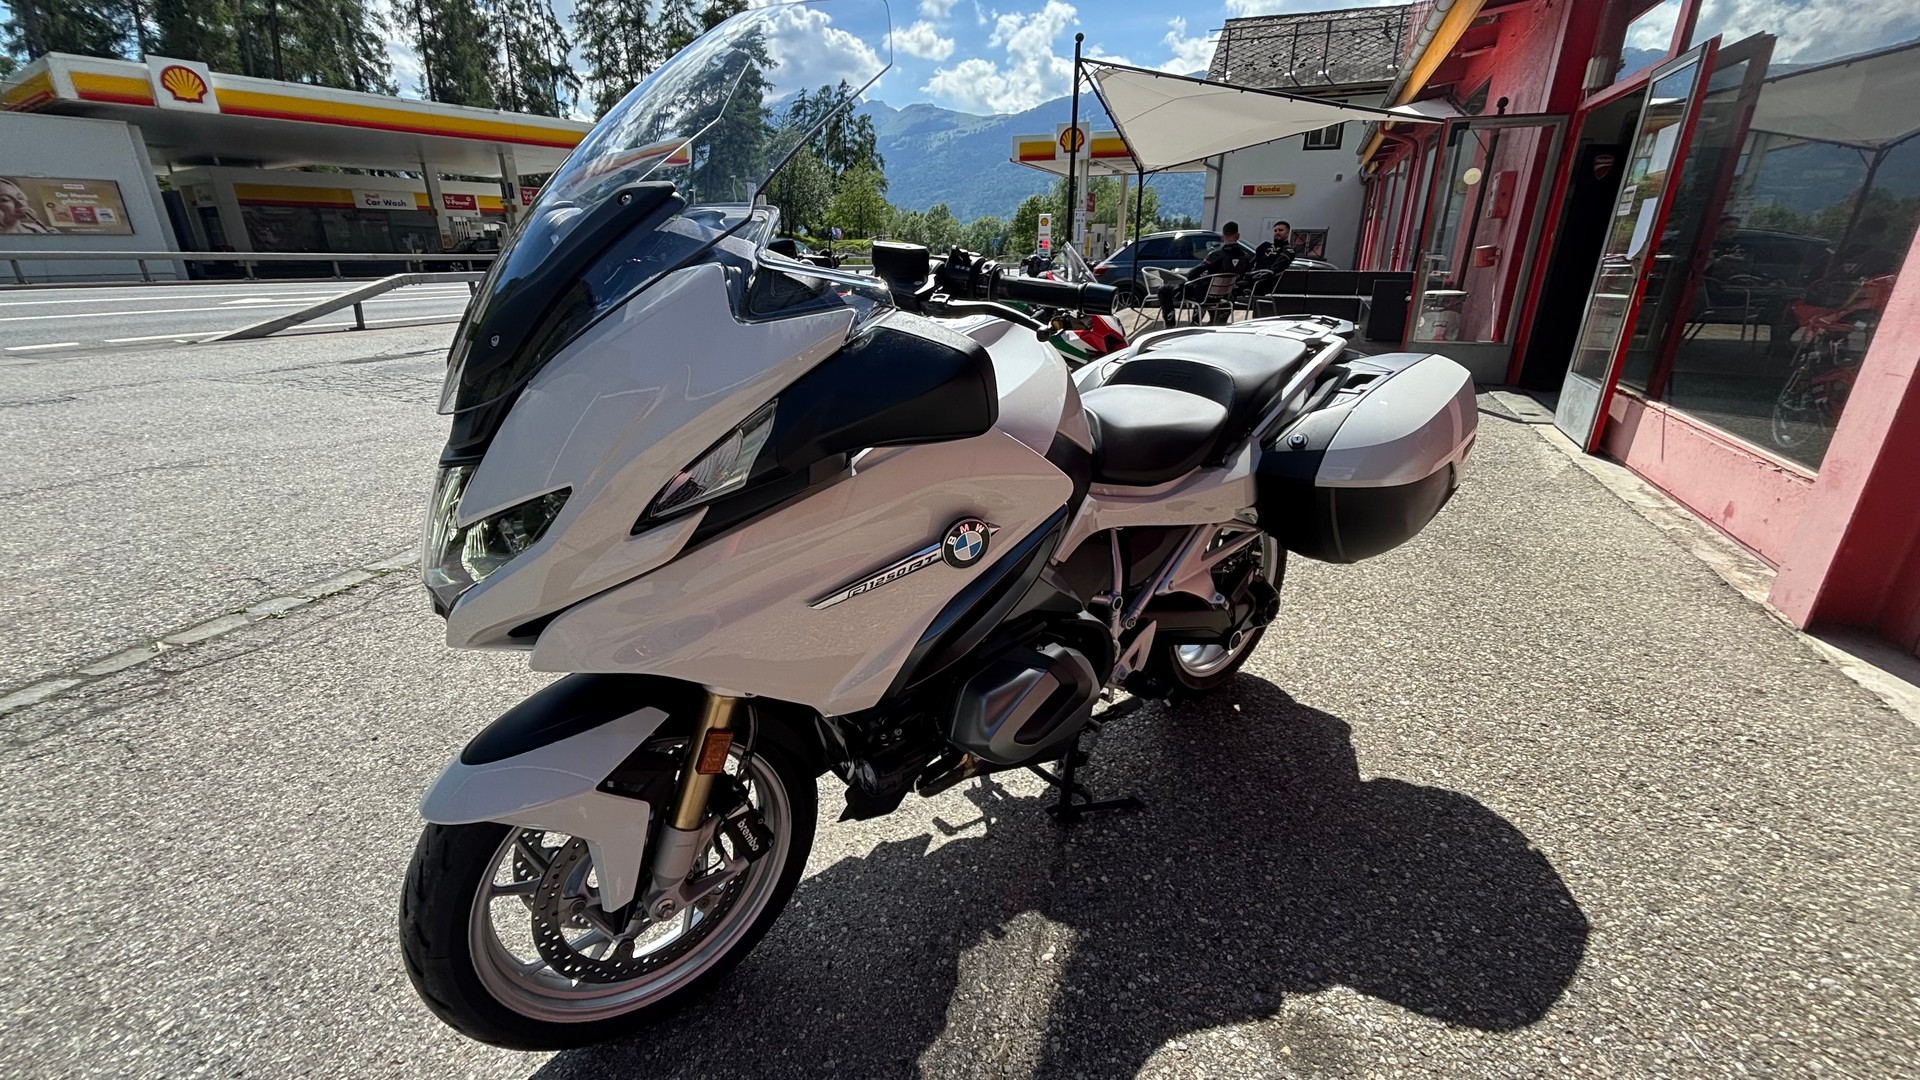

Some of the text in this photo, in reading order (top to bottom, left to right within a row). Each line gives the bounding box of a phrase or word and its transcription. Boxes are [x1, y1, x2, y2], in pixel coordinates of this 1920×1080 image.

[365, 198, 407, 207] Car Wash
[737, 818, 759, 851] brembo
